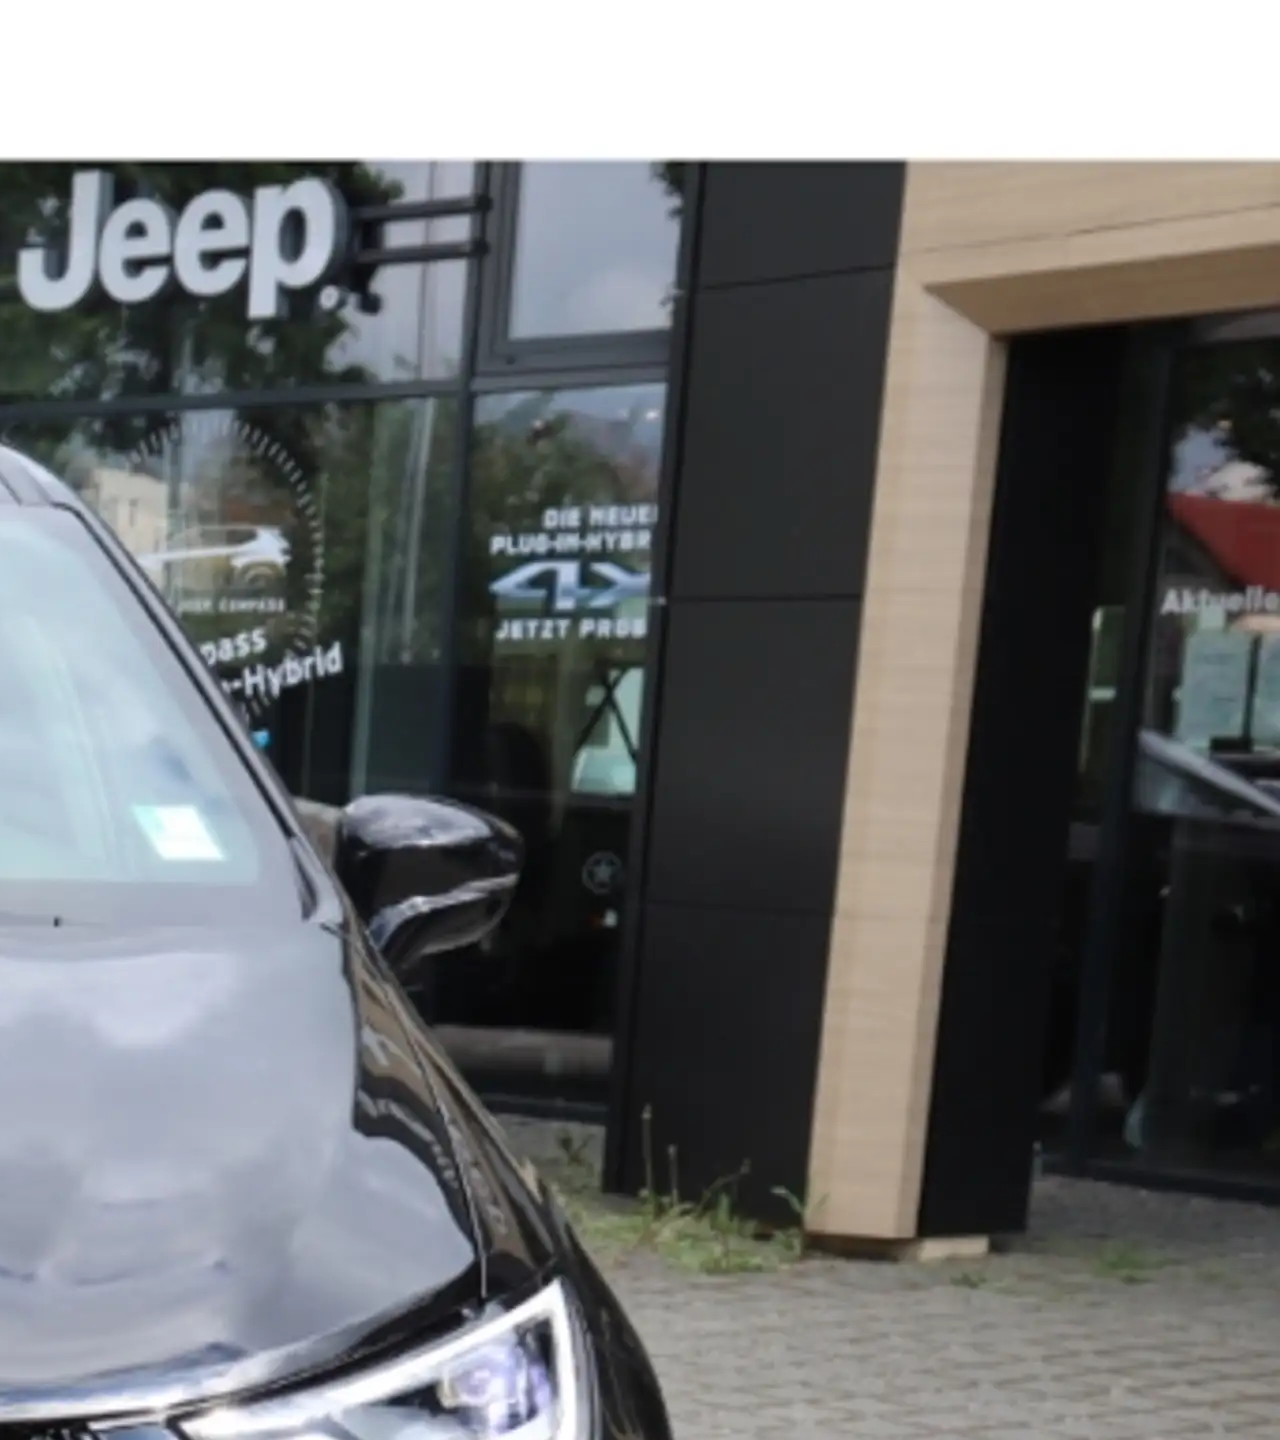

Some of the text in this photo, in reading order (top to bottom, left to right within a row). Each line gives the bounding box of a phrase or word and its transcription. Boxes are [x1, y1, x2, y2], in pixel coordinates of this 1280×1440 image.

[17, 169, 336, 319] Jeep
[543, 507, 581, 530] DIE
[496, 617, 571, 641] JETZT
